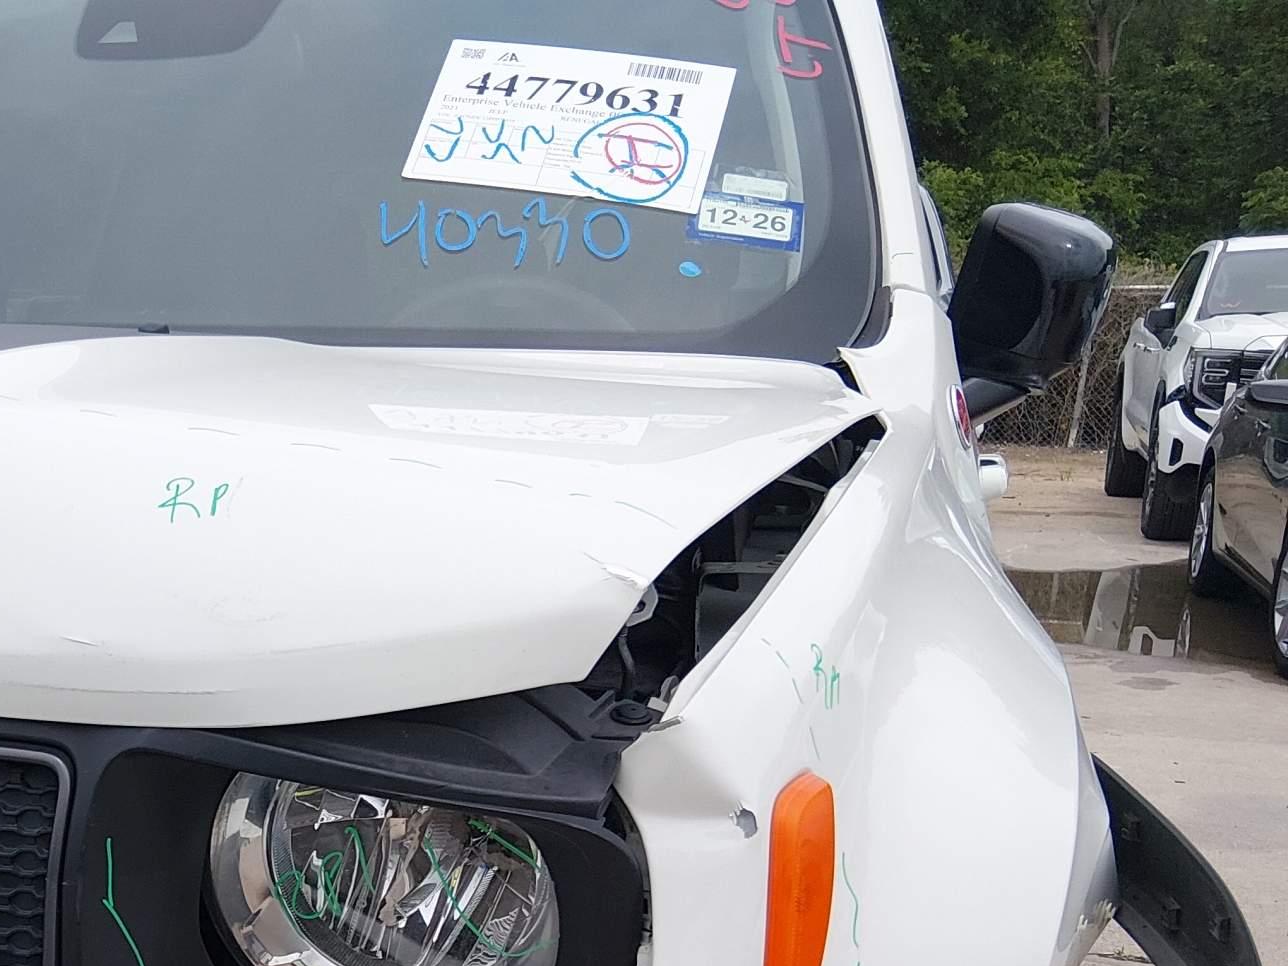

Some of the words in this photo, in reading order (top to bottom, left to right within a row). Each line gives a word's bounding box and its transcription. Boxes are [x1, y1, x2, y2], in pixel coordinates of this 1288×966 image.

[465, 71, 685, 119] 44779631
[706, 207, 738, 226] 12
[752, 212, 787, 232] 26
